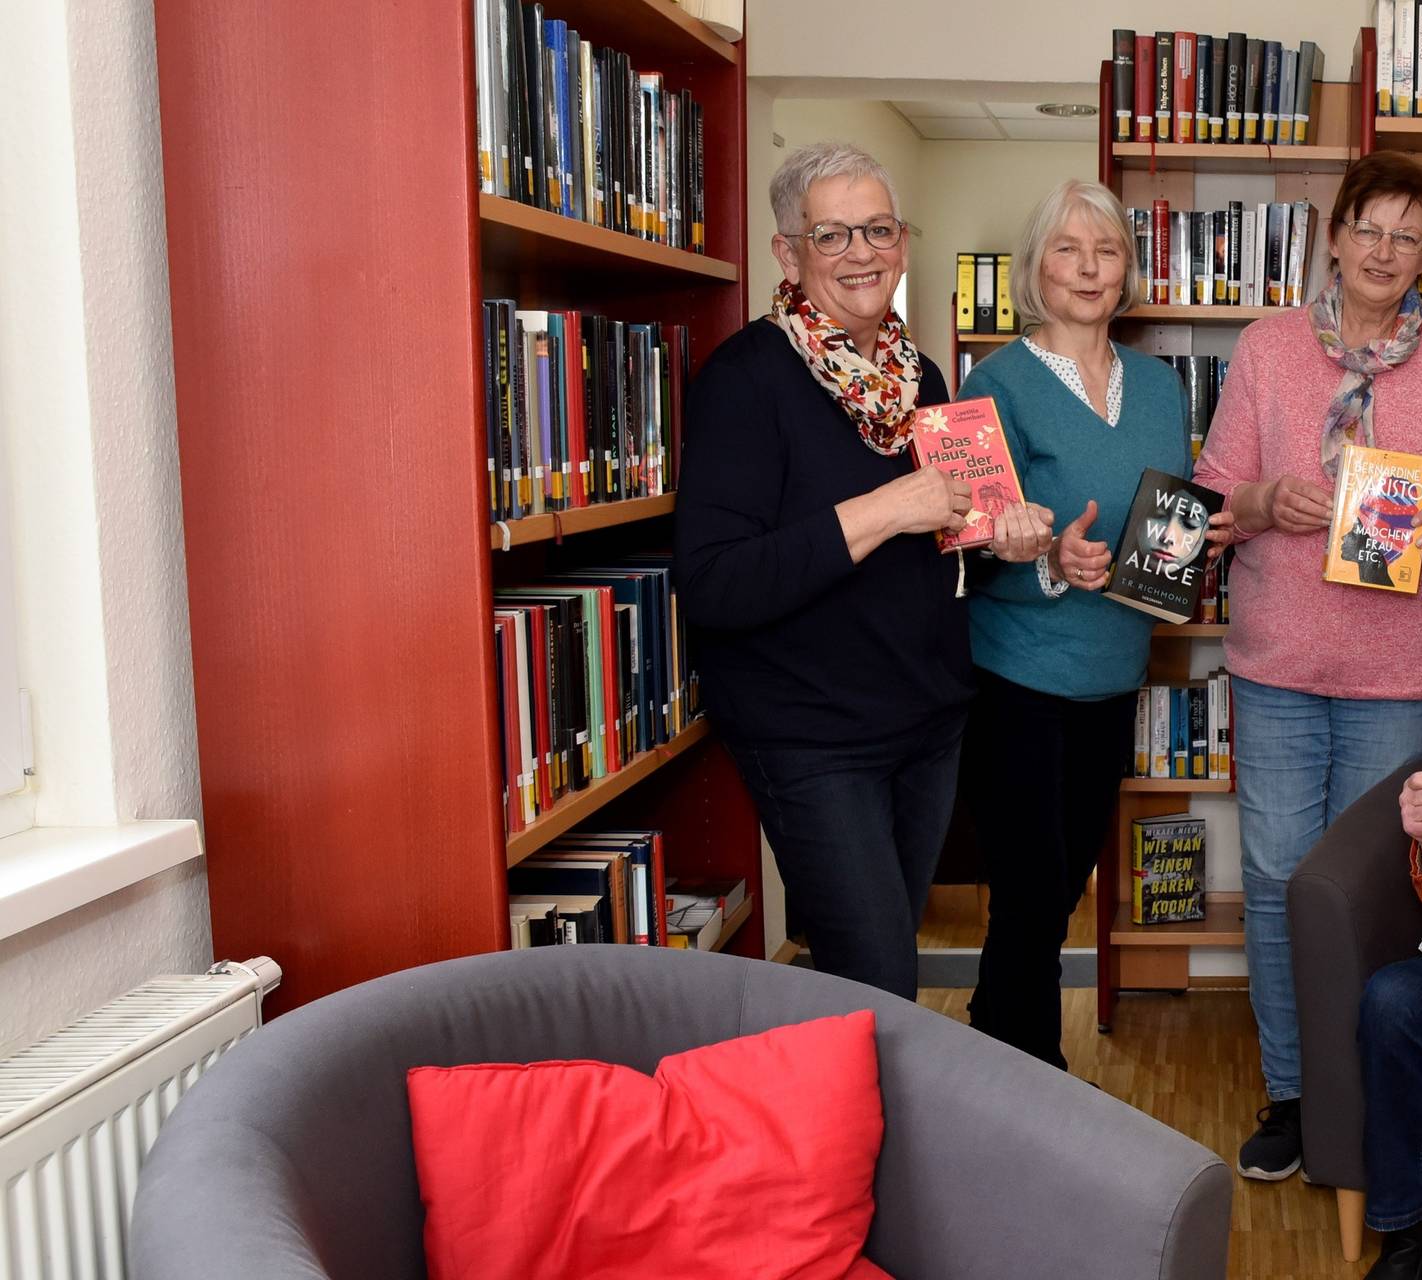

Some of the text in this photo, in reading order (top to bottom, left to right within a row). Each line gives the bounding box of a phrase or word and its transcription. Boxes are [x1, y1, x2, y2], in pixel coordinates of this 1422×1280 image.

[941, 436, 972, 451] Das
[927, 449, 968, 465] Haus
[966, 455, 993, 469] der
[950, 463, 1005, 482] Frauen
[1354, 460, 1421, 481] BERNARDINE
[1156, 488, 1203, 522] WER
[1146, 519, 1196, 552] WAR
[1365, 538, 1394, 552] FRAU
[1358, 549, 1382, 564] ETC.
[1125, 550, 1196, 587] ALICE
[1138, 582, 1189, 606] RICHMOND
[1144, 836, 1202, 856] WIE MAN
[1152, 856, 1194, 875] EINEN
[1151, 897, 1194, 916] KOCHT
